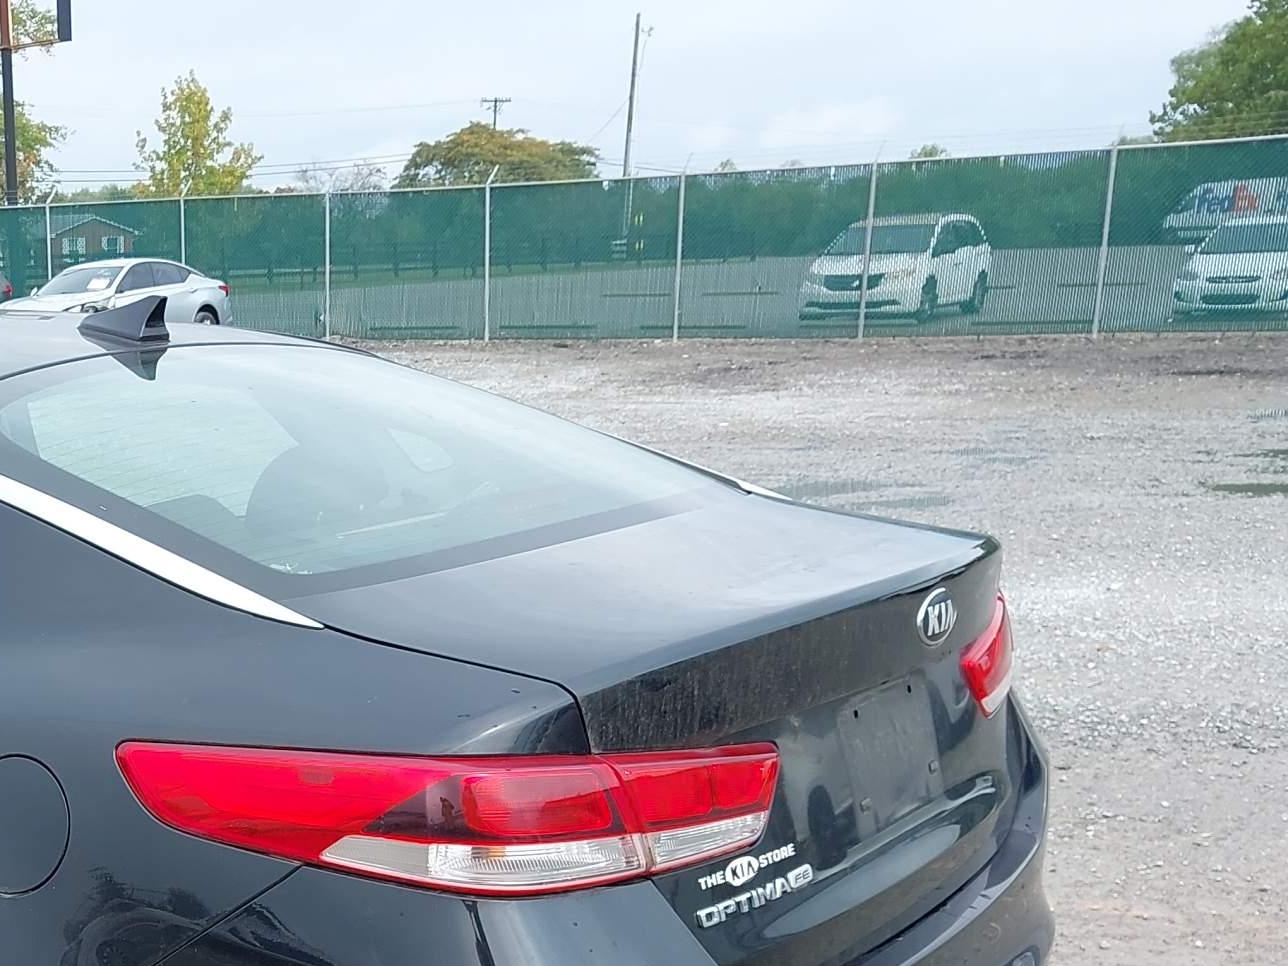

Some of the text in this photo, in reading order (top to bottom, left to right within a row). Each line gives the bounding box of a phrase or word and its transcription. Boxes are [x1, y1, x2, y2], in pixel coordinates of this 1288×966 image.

[927, 599, 953, 636] KIA
[698, 842, 796, 891] THE KIA STORE
[696, 877, 792, 928] OPTIMA
